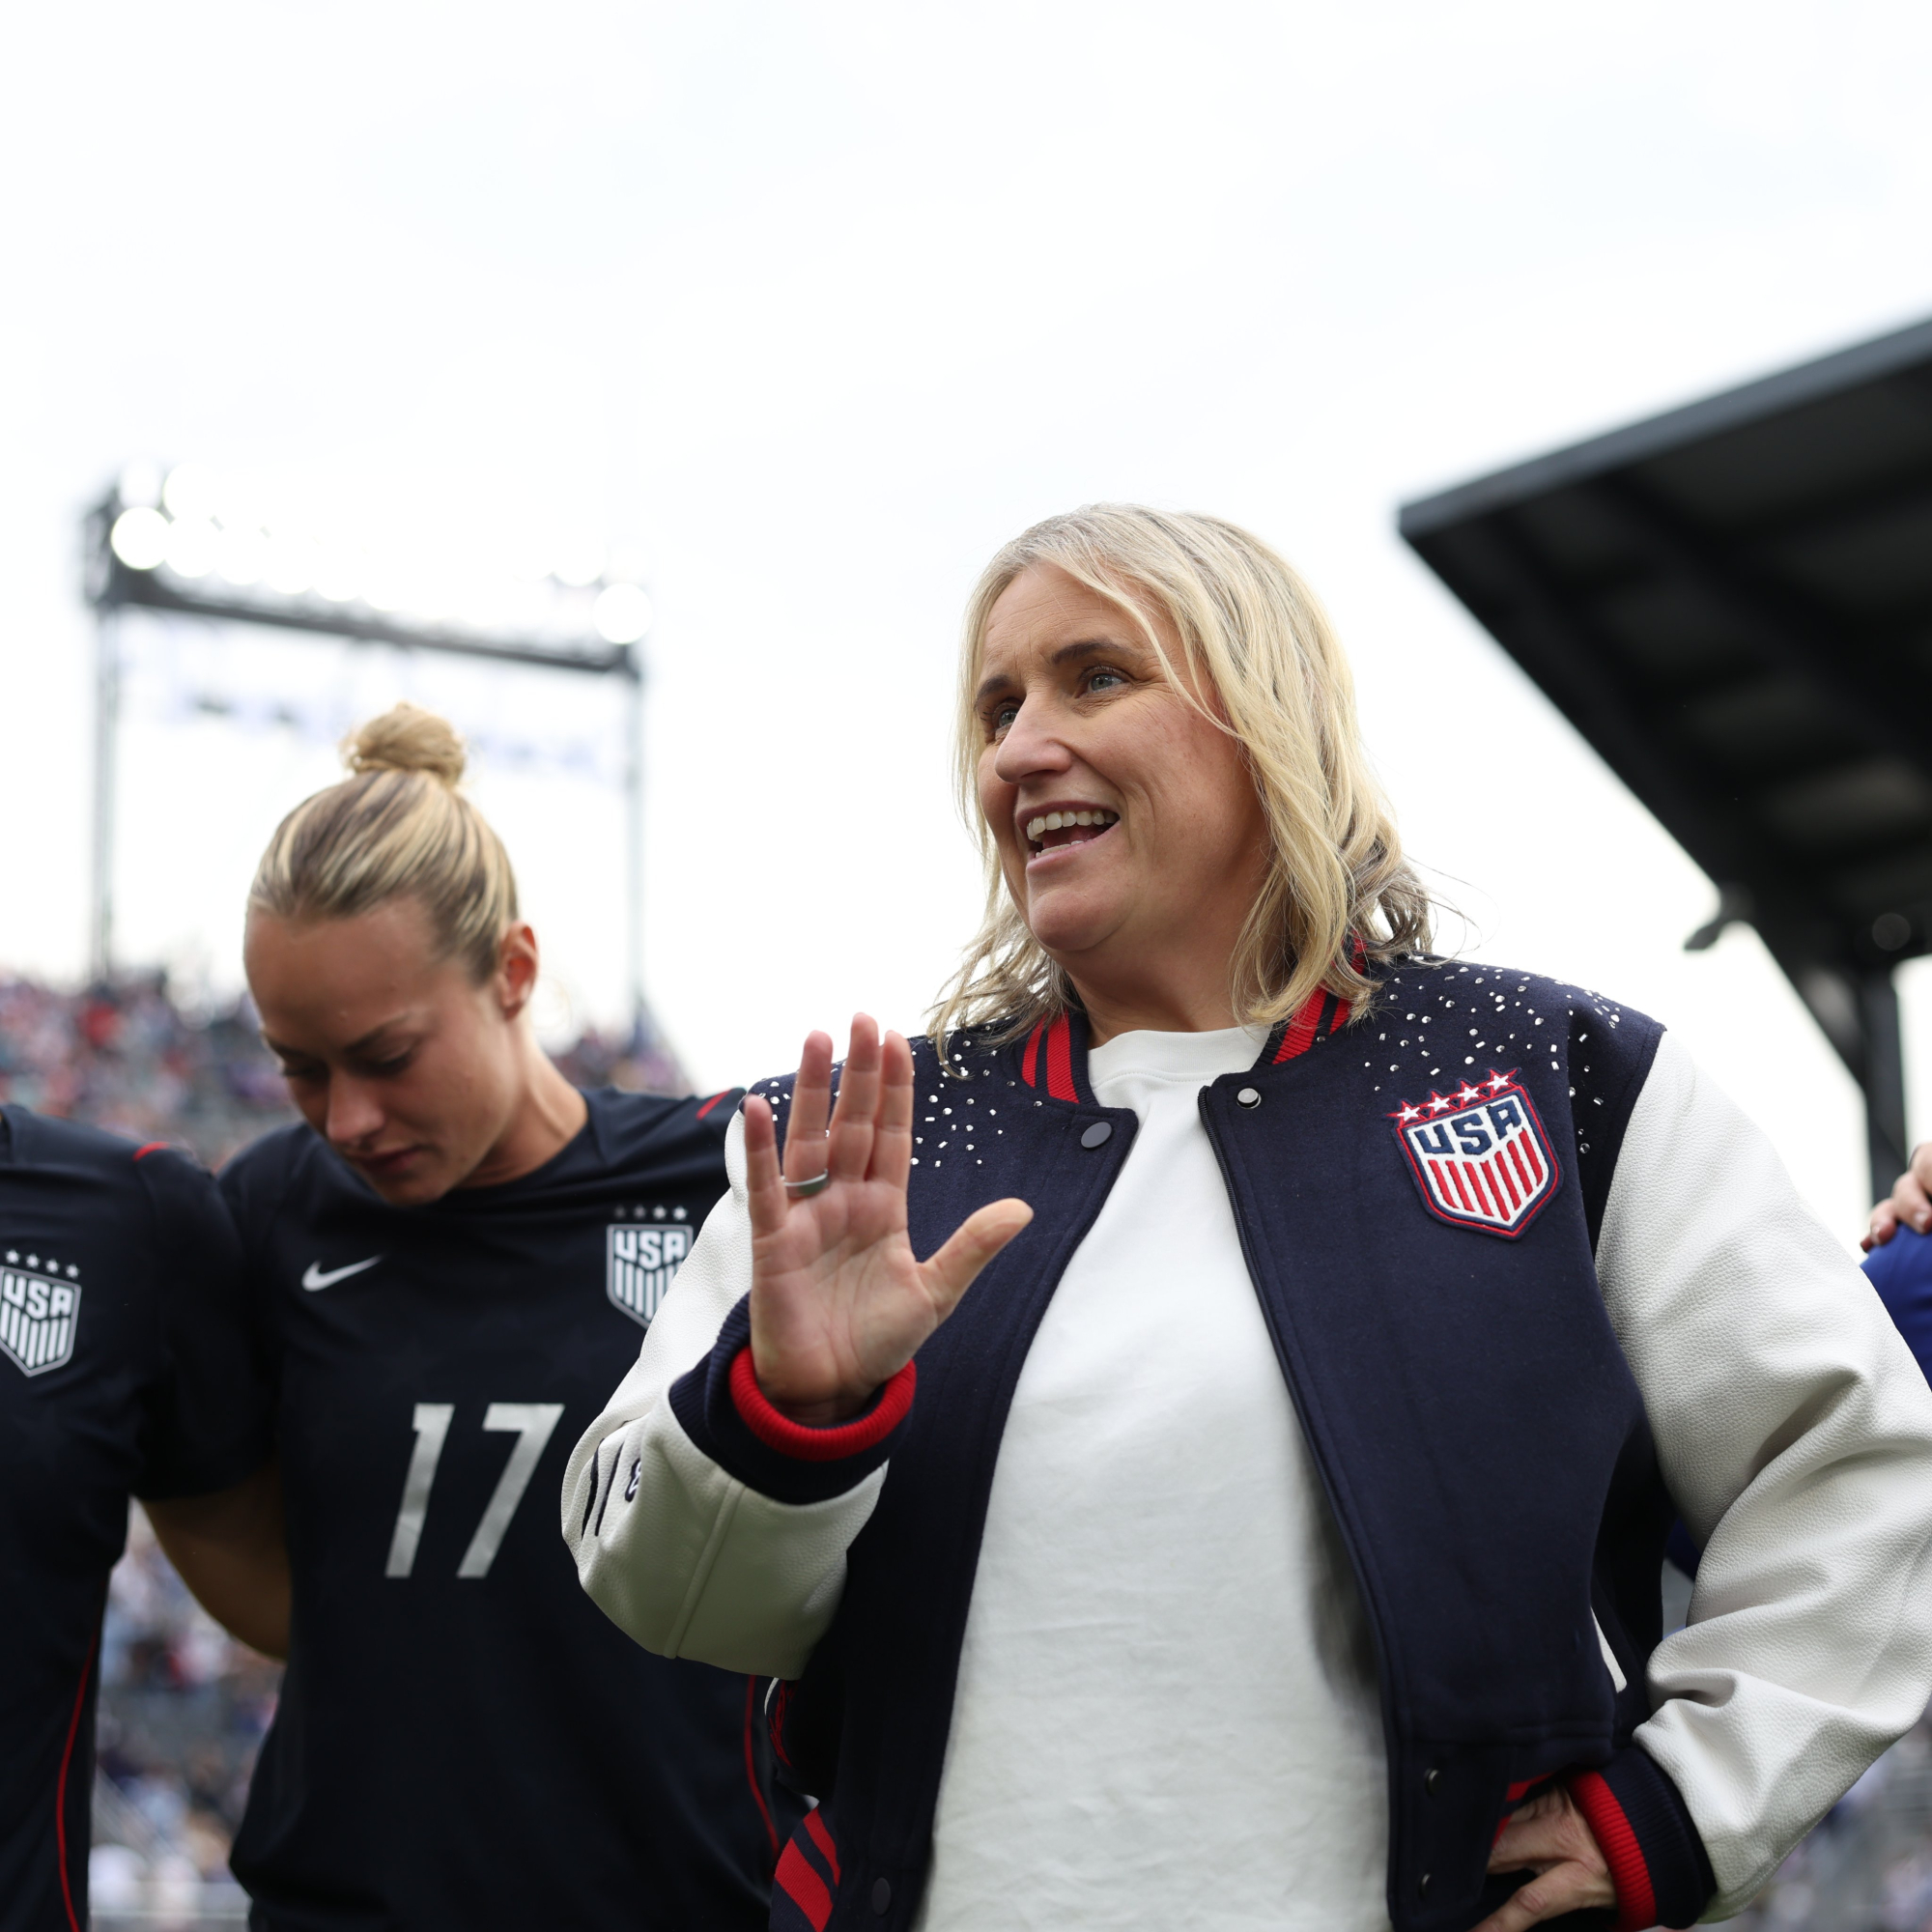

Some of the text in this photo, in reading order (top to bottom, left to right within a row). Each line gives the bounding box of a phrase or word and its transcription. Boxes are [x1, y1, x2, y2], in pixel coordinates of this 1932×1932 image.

[1414, 1099, 1521, 1155] USA
[614, 1230, 686, 1270] USA
[3, 1273, 73, 1320] USA
[385, 1403, 565, 1578] 17
